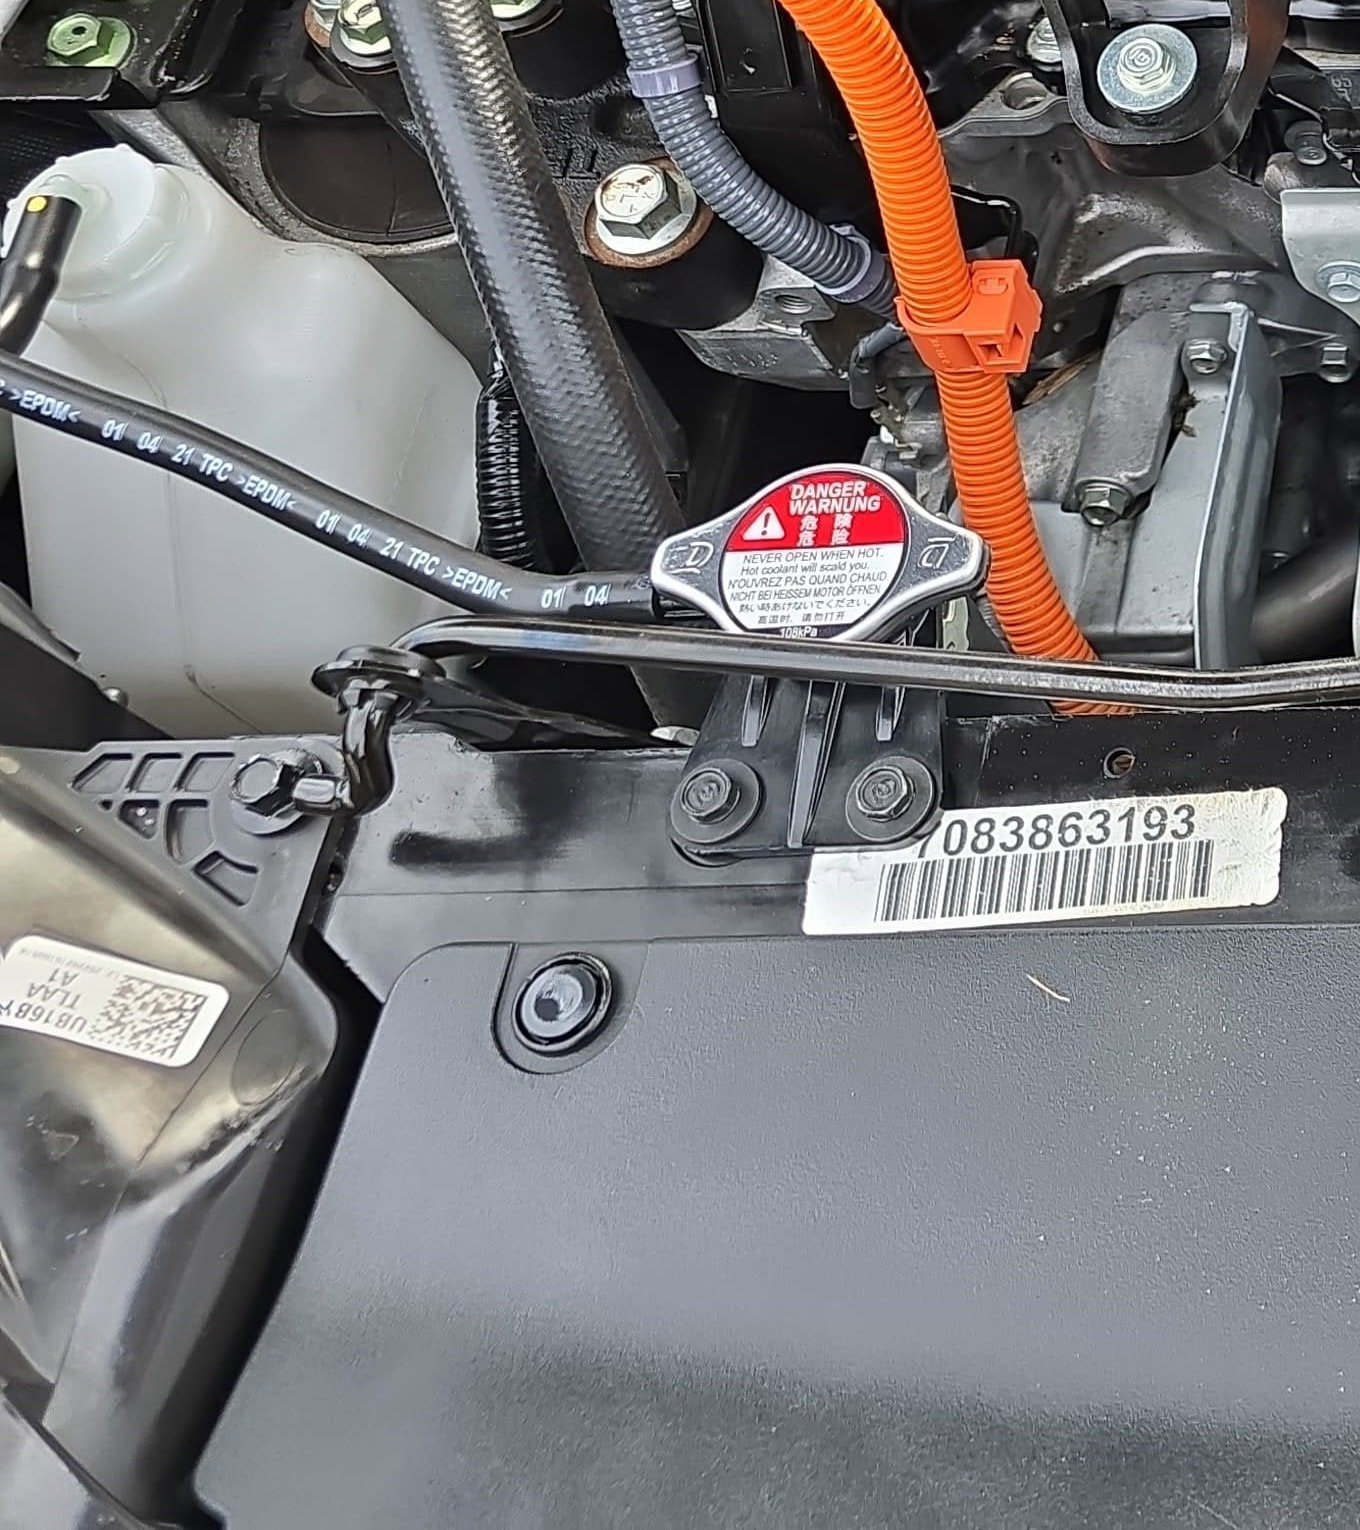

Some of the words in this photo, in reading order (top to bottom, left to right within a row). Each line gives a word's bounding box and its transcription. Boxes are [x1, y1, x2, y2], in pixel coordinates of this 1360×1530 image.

[791, 480, 866, 500] DANGER
[789, 494, 881, 515] WARNUNG
[199, 452, 234, 483] TPC
[407, 546, 440, 577] TPC
[743, 552, 782, 565] NEVER
[785, 551, 818, 563] OPEN
[820, 549, 855, 562] WHEN
[857, 548, 884, 559] HOT.
[740, 566, 765, 576] Hot
[766, 564, 799, 575] coolant
[800, 562, 818, 573] will
[819, 562, 849, 572] scald
[850, 562, 870, 573] you.
[728, 576, 782, 590] N'OUVREZ
[785, 575, 807, 587] PAS
[809, 574, 847, 586] QUAND
[850, 572, 888, 584] CHAUD.
[730, 590, 757, 602] NICHT
[758, 589, 772, 600] BEI
[773, 587, 812, 600] HEISSEM
[813, 586, 846, 598] MOTOR
[846, 584, 881, 596] ÖFFNEN
[779, 627, 818, 638] 108kPa
[47, 968, 79, 987] A1
[27, 982, 82, 1010] TLAA
